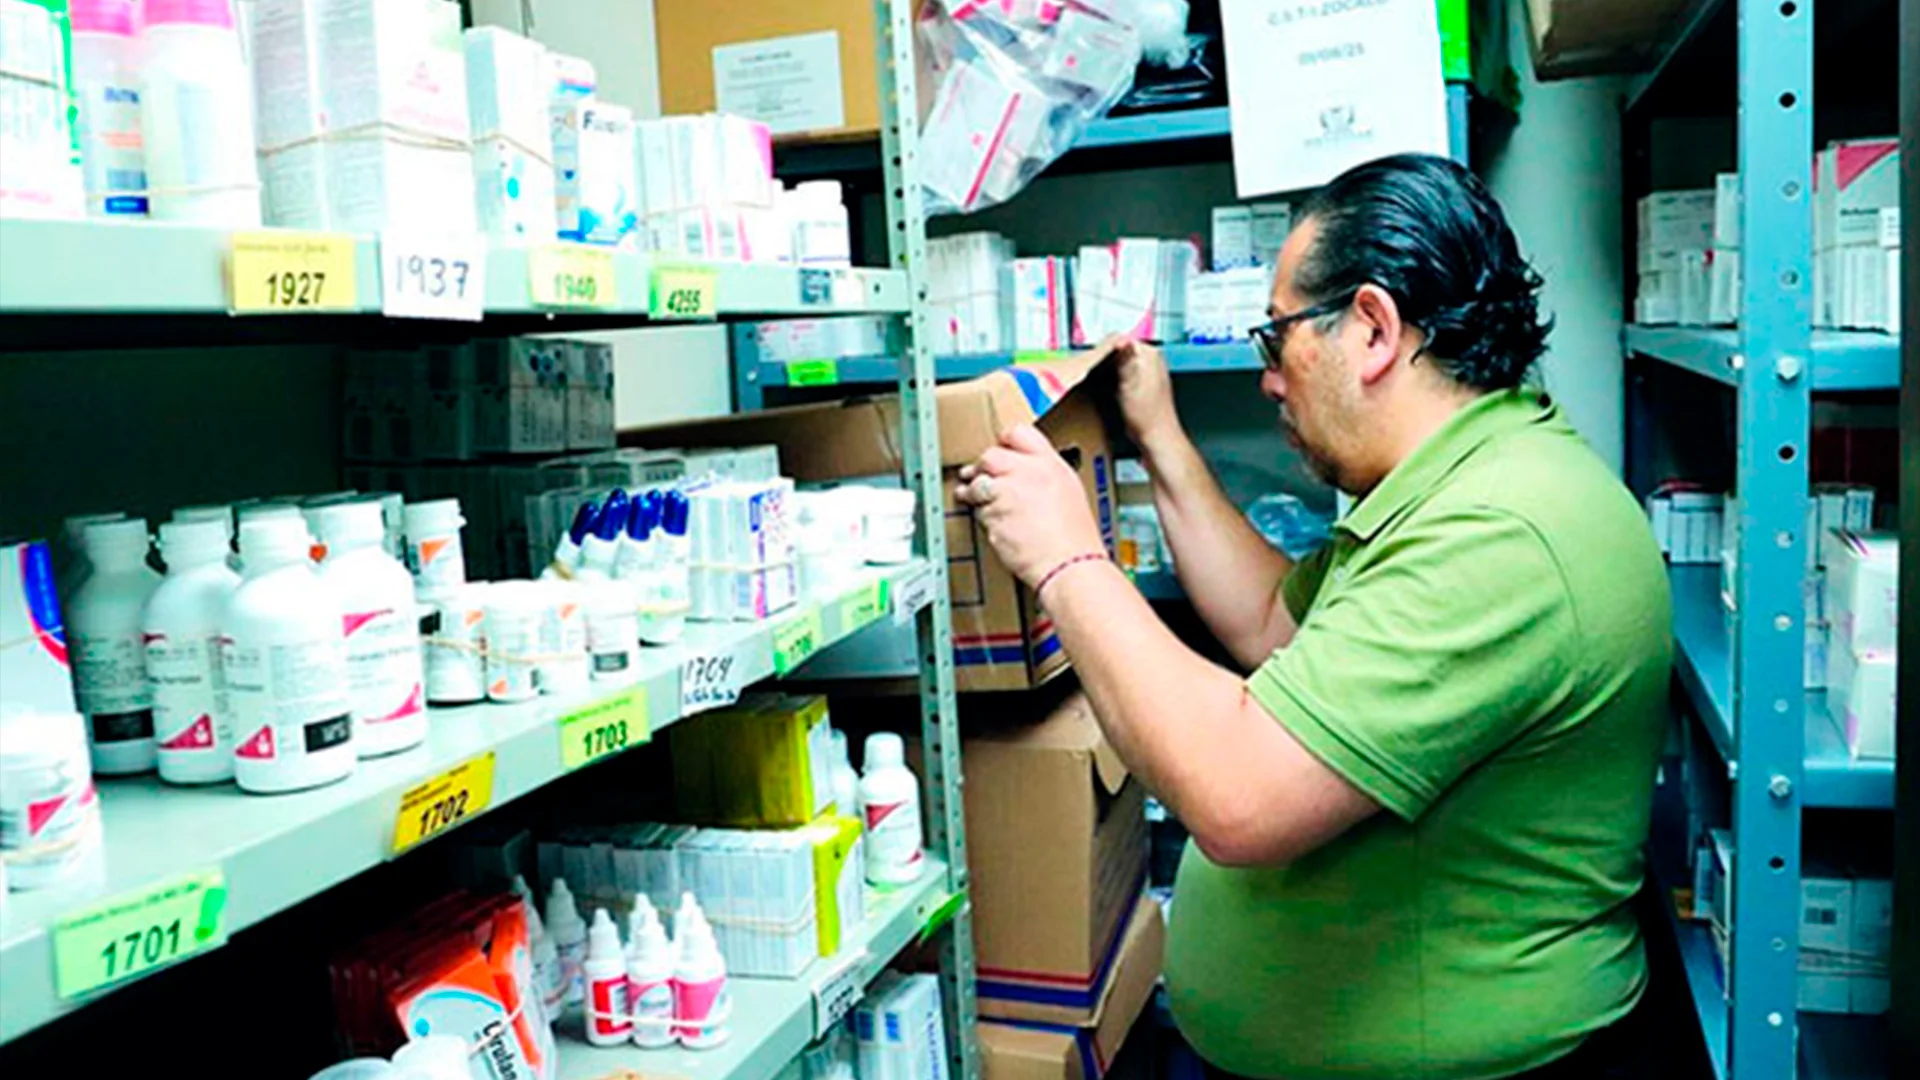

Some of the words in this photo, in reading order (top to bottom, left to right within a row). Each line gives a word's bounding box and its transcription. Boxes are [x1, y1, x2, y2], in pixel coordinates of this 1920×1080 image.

[266, 272, 326, 306] 1927
[396, 254, 471, 298] 1937
[553, 273, 598, 301] 1940
[583, 719, 628, 757] 1703
[420, 788, 470, 836] 1702
[100, 918, 182, 978] 1701
